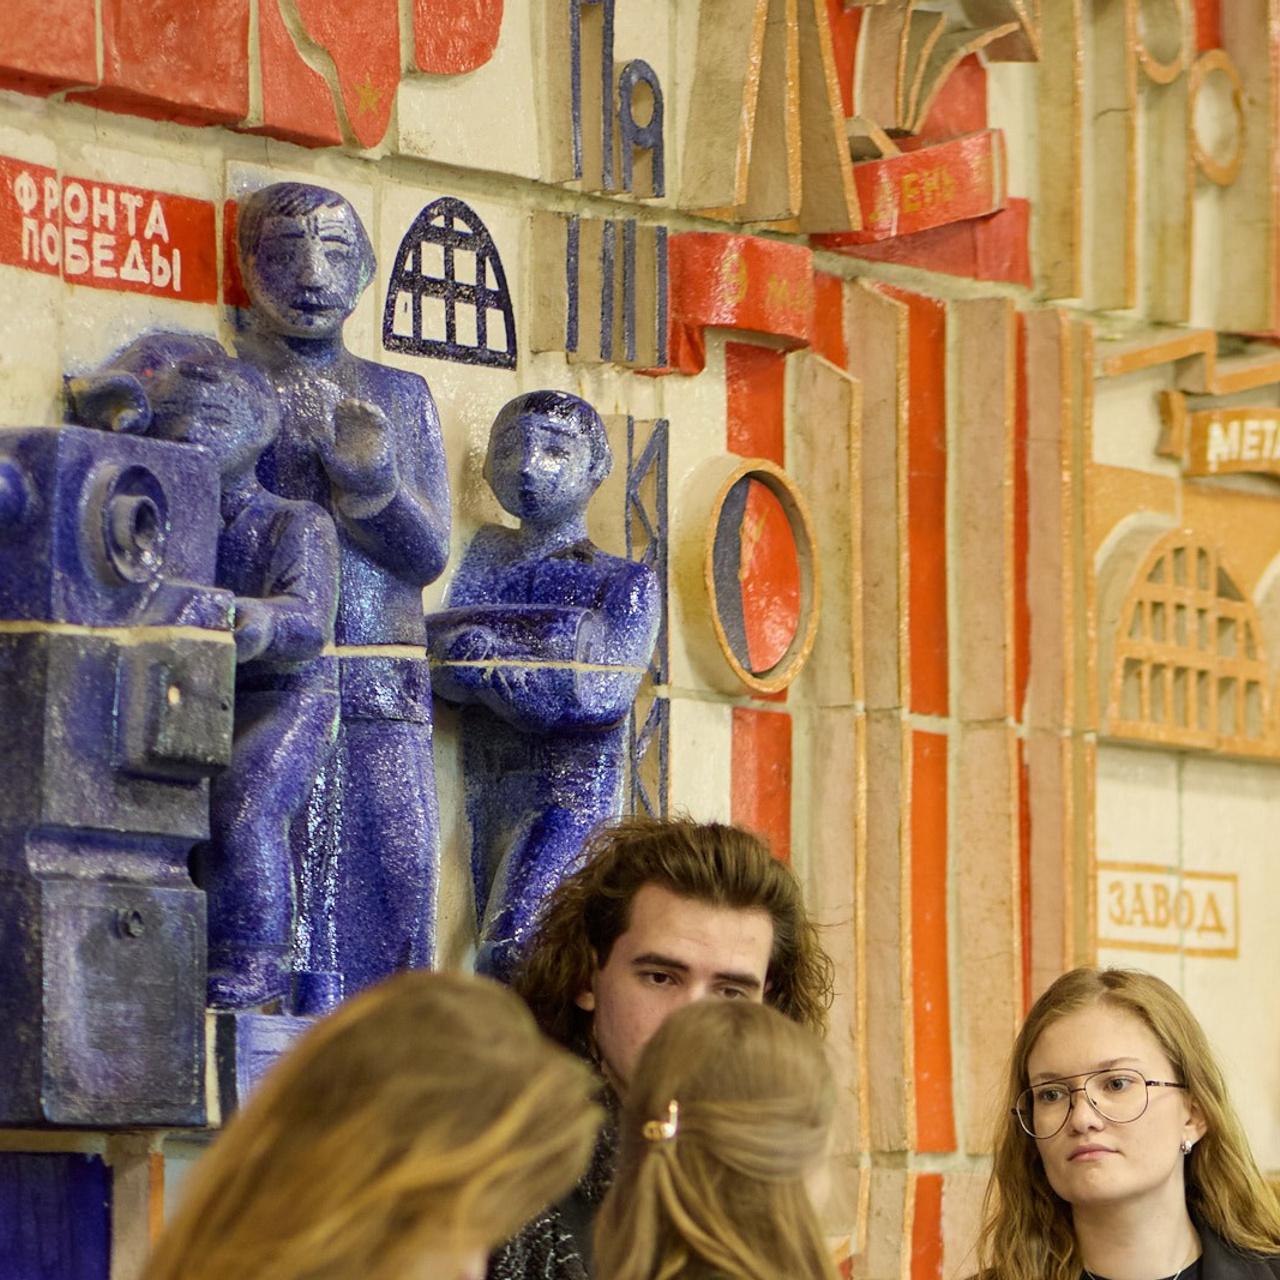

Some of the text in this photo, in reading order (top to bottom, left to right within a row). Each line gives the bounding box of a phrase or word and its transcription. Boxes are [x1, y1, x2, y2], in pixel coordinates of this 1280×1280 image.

[13, 171, 170, 244] ФРОНТА
[21, 217, 182, 292] ПОБЕДЫ
[1107, 880, 1227, 939] ЗАВОД
